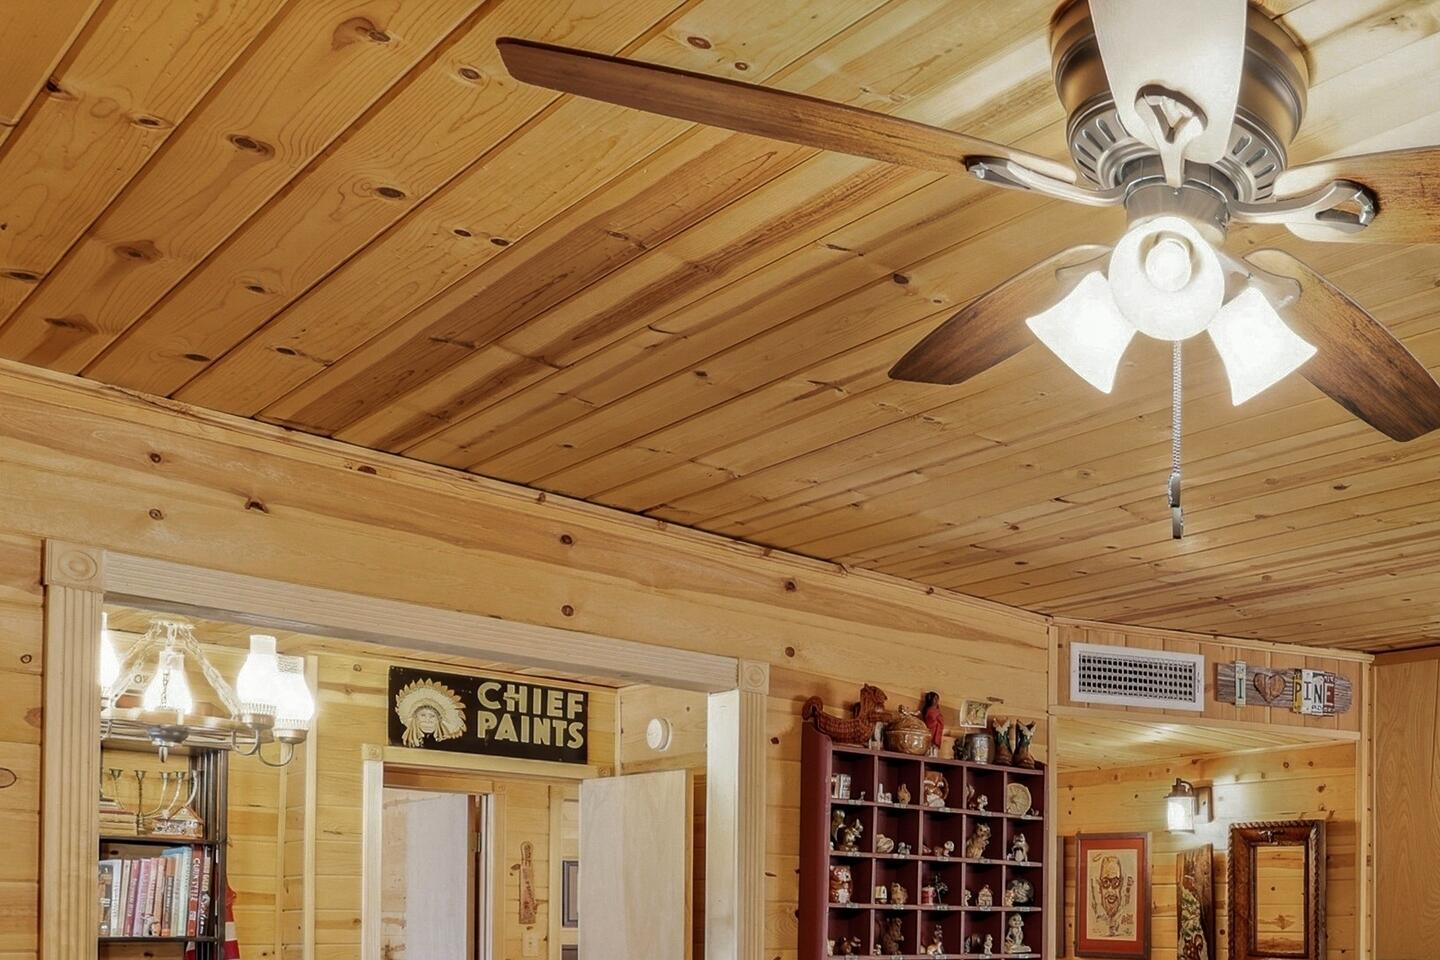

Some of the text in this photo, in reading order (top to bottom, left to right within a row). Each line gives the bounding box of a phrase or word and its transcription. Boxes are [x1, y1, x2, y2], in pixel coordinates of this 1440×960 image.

[477, 681, 584, 720] CHIEF
[1294, 680, 1335, 707] PINE
[477, 710, 584, 749] PAINTS
